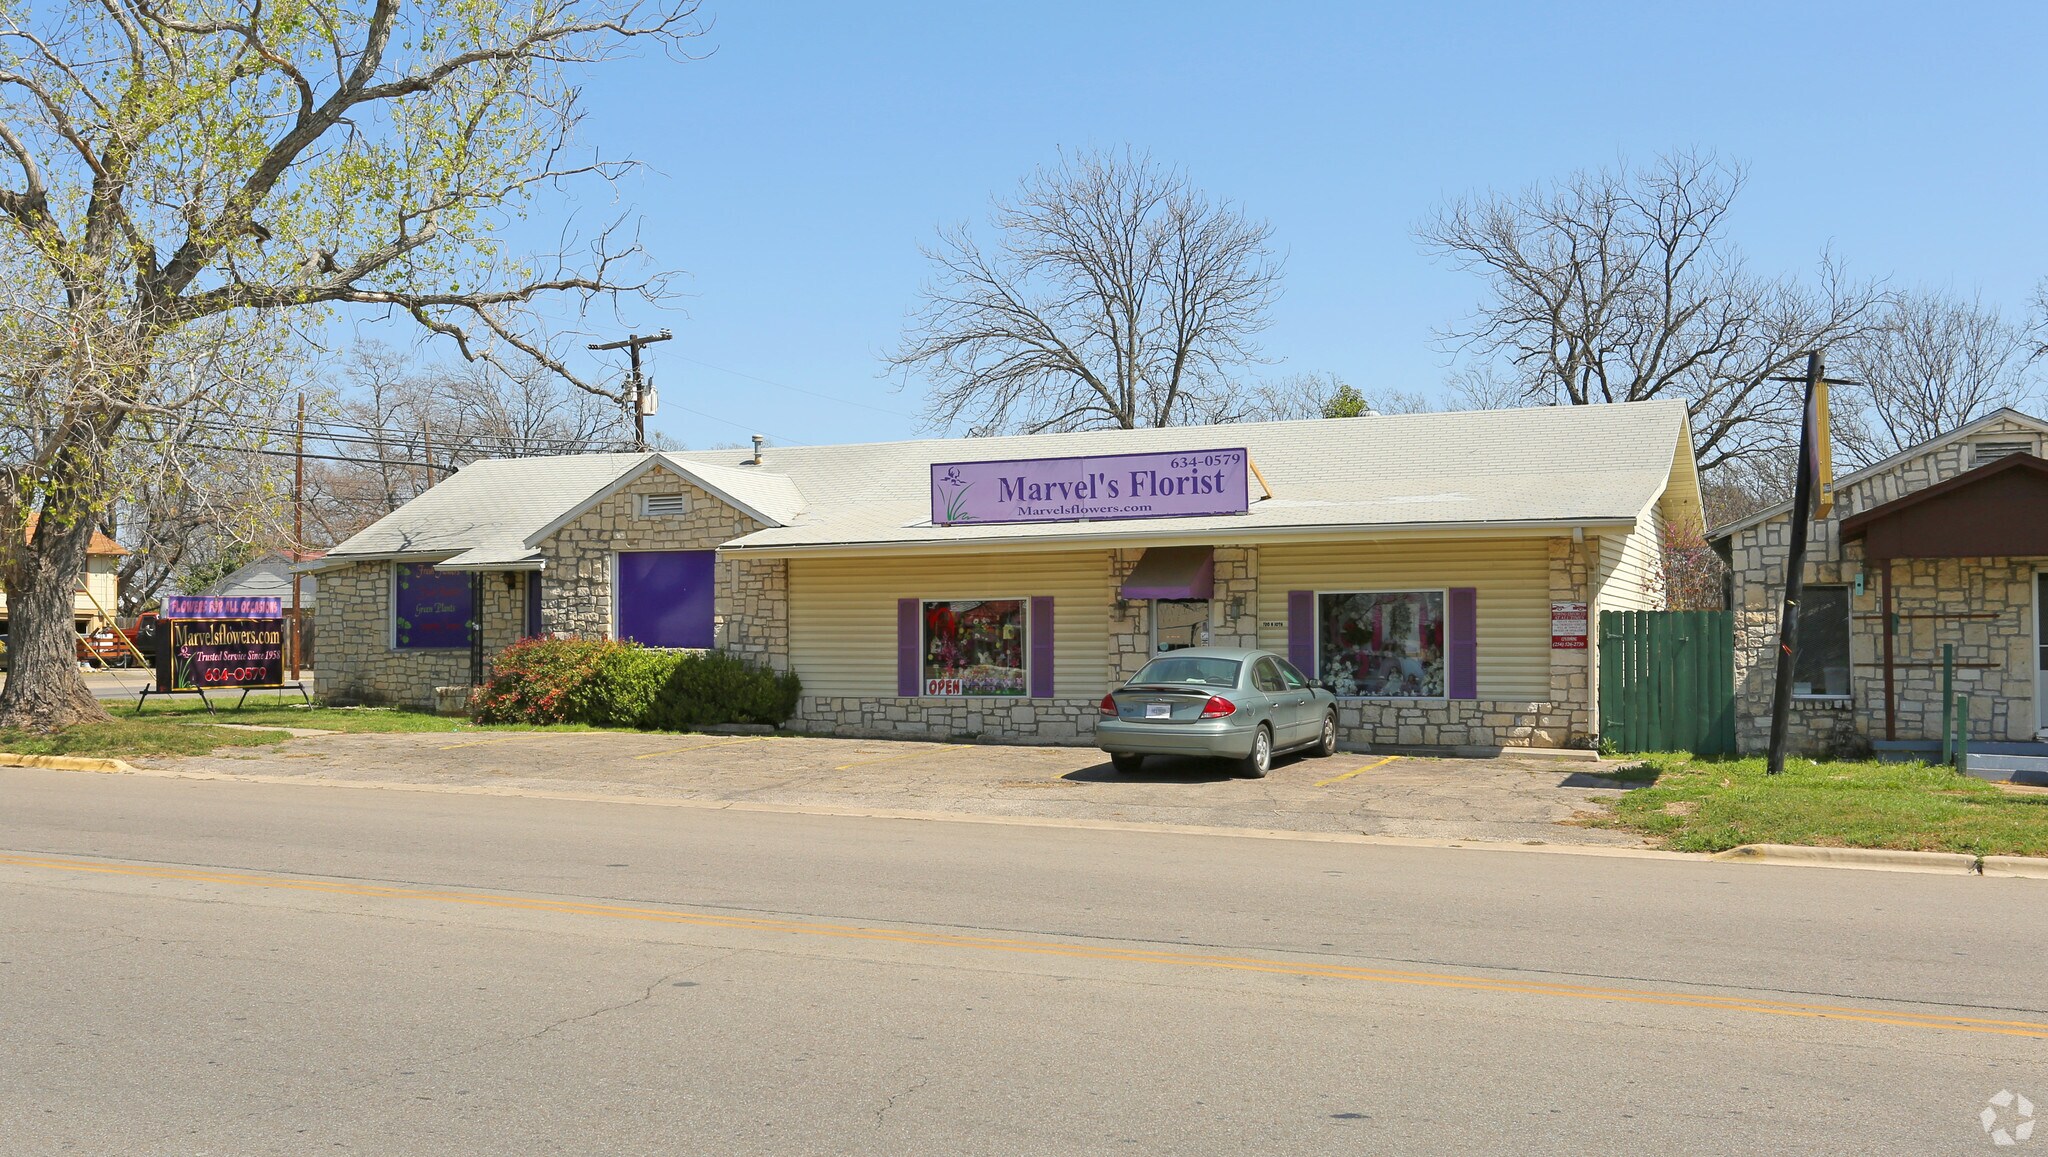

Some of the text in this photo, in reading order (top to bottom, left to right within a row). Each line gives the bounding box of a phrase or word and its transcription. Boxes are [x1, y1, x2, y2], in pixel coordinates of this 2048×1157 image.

[1170, 453, 1241, 469] 634-0579
[998, 468, 1225, 502] Marvel's Florist
[1017, 503, 1153, 517] Marvelsflowers.com
[171, 600, 278, 613] FLOWERS FOR ALL OCCASIONS
[175, 623, 280, 647] Marvelsflowers.com
[197, 650, 281, 662] Trusted Service Since 1958
[204, 667, 267, 682] 634-0579
[928, 679, 960, 696] OPEN
